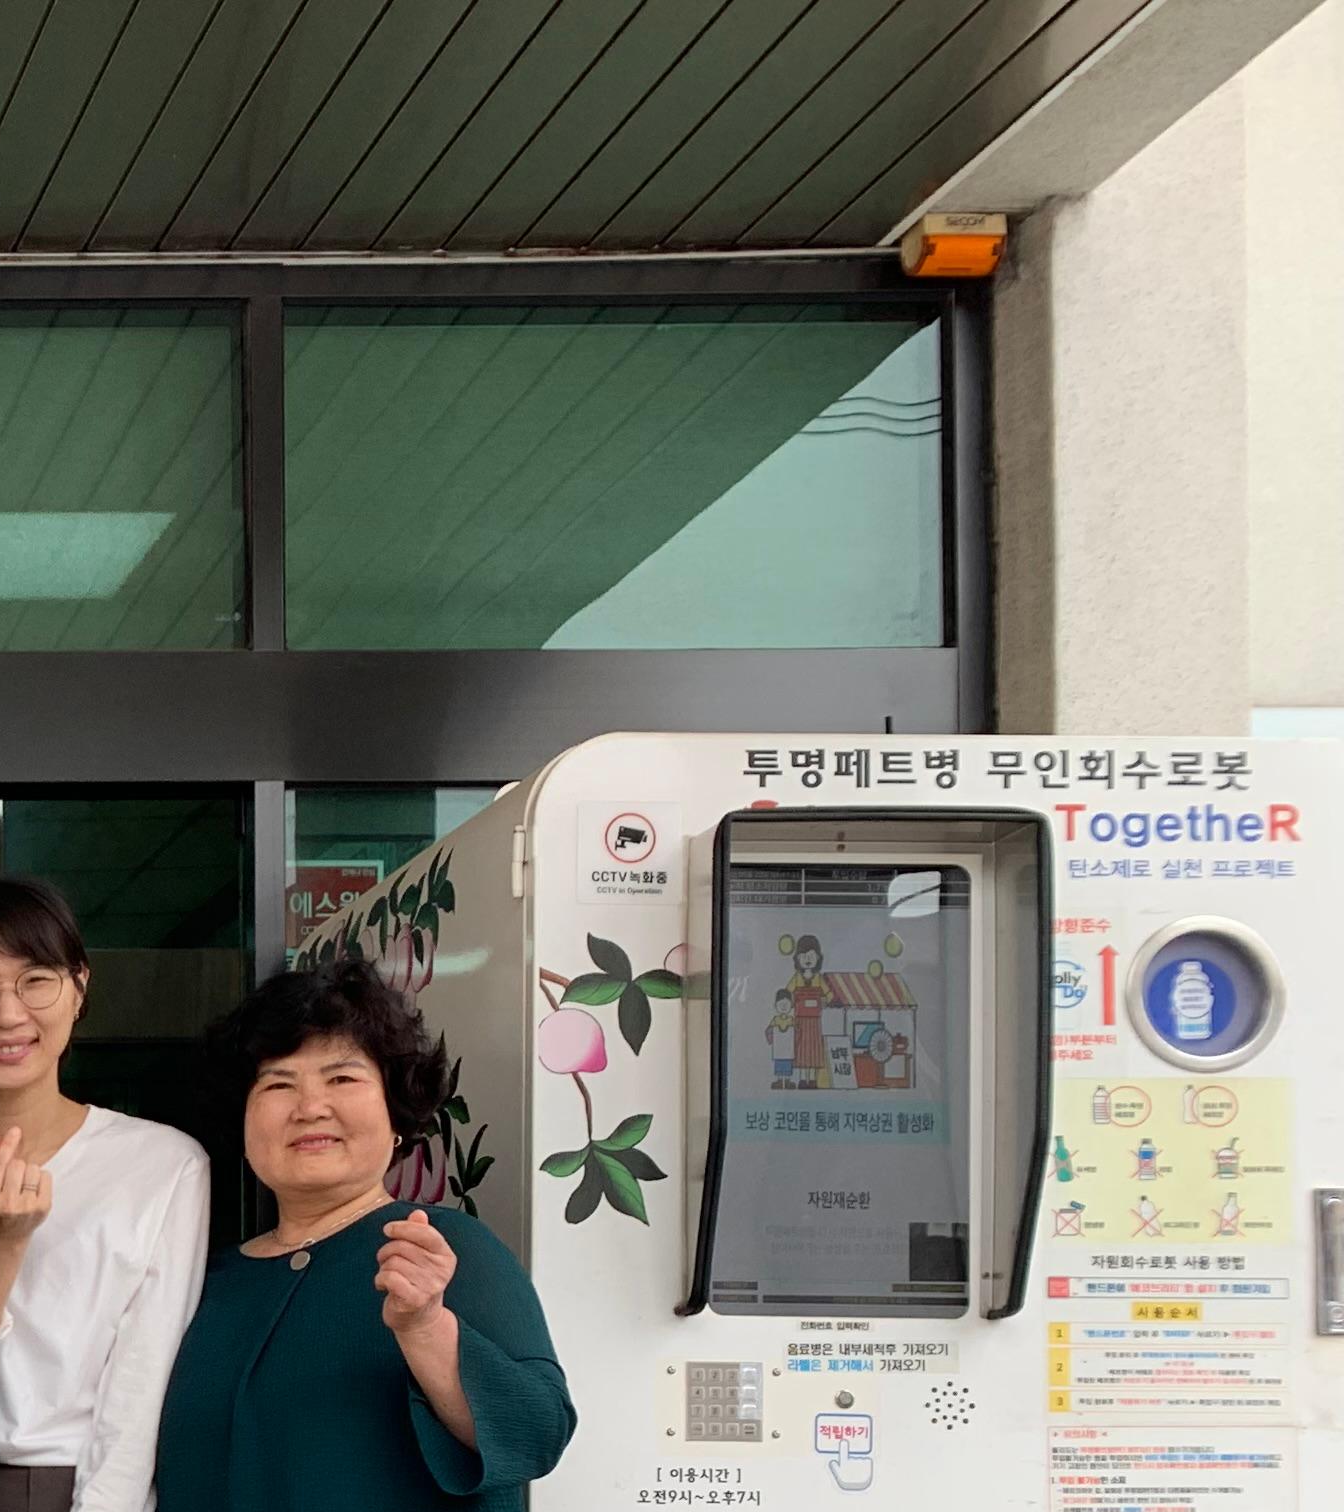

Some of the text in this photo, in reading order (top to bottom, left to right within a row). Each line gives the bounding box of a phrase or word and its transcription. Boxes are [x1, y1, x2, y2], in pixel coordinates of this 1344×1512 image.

[742, 749, 1253, 792] 투명페트병 무인회수로봇
[1055, 803, 1302, 848] TogetheR
[1068, 858, 1297, 880] 탄소제로 실천 프로젝트
[591, 871, 668, 884] CCTV 녹화중
[745, 1111, 769, 1131] 보상
[897, 1112, 935, 1134] 활성화
[808, 1191, 870, 1209] 자원재순환
[1091, 1255, 1245, 1270] 자원회수로봇 사용 방법
[800, 1321, 833, 1330] 전화번호
[787, 1343, 949, 1356] 음료병은 내부세척후 가져오기
[827, 1359, 874, 1372] 제거해서
[880, 1359, 926, 1372] 가져오기
[819, 1426, 868, 1440] 적립하기
